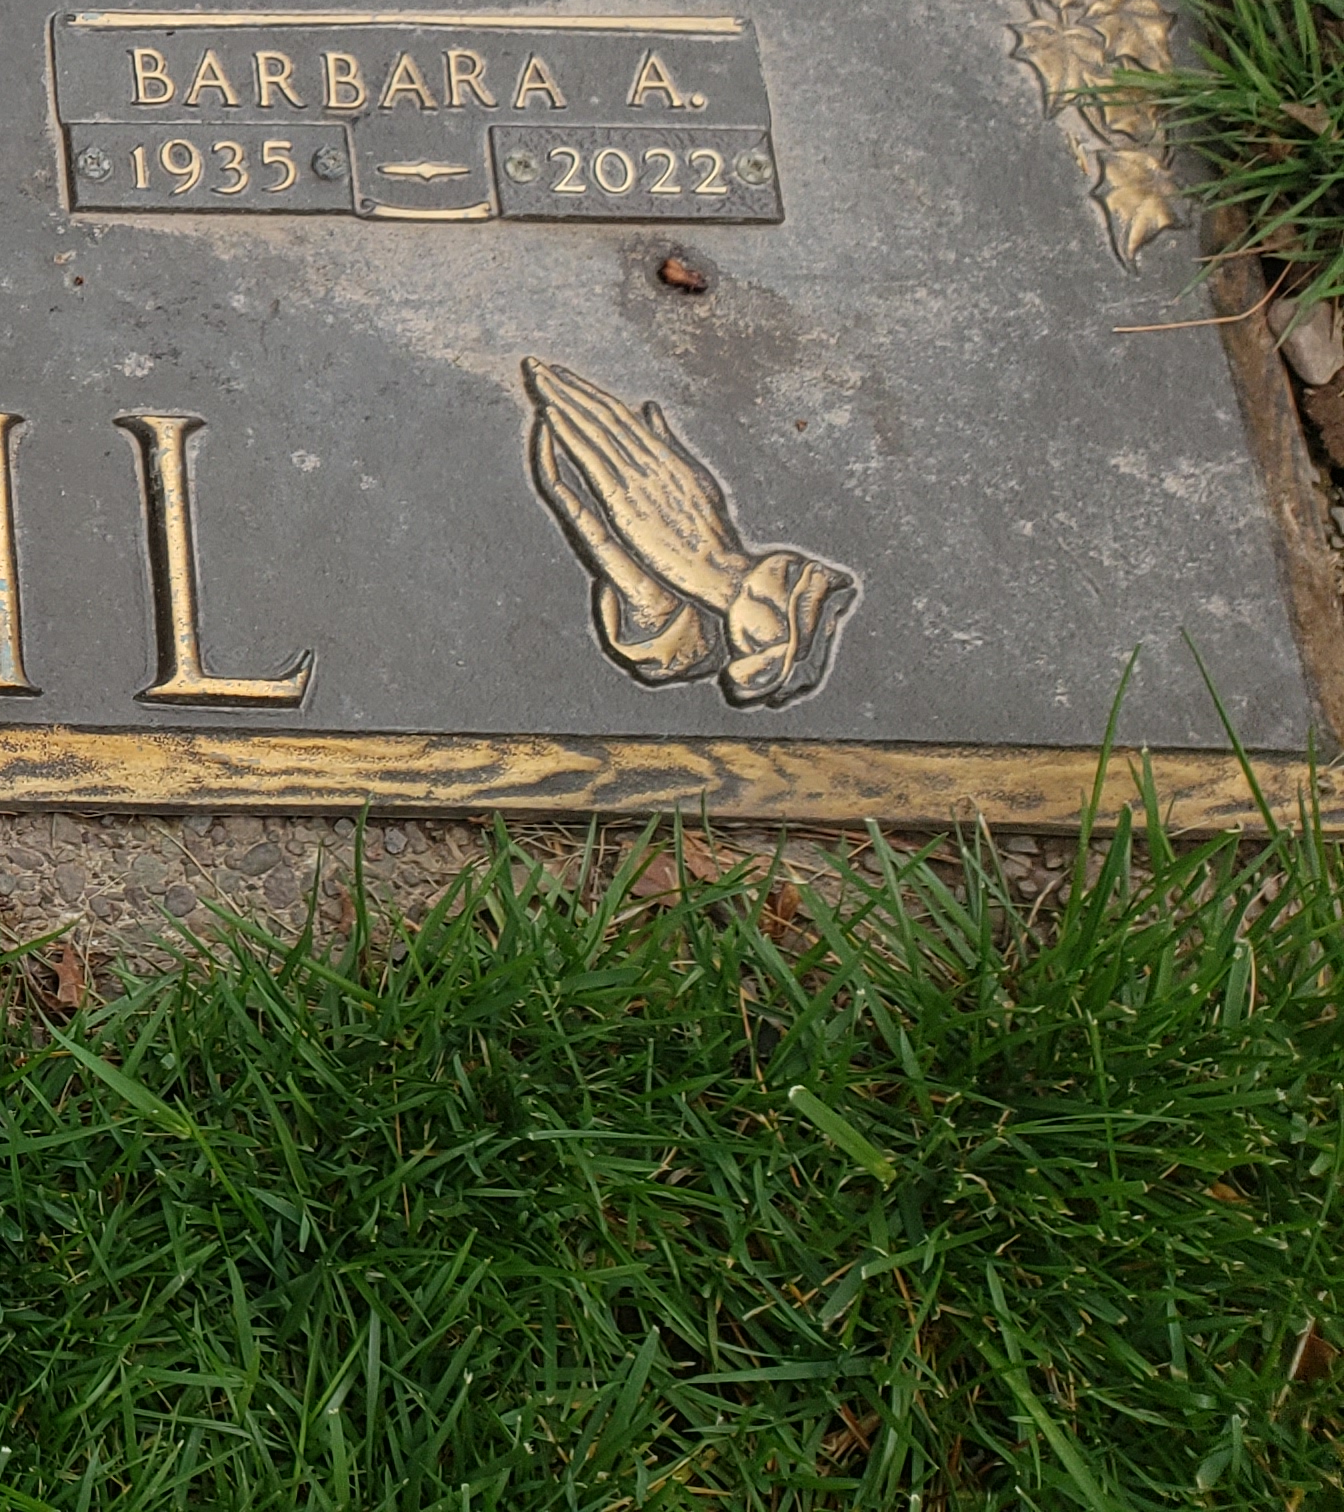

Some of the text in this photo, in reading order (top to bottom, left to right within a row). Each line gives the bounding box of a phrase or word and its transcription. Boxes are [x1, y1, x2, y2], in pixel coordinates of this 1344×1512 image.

[129, 47, 708, 111] BARBARA A.
[131, 139, 300, 194] 1935
[547, 146, 729, 195] 2022
